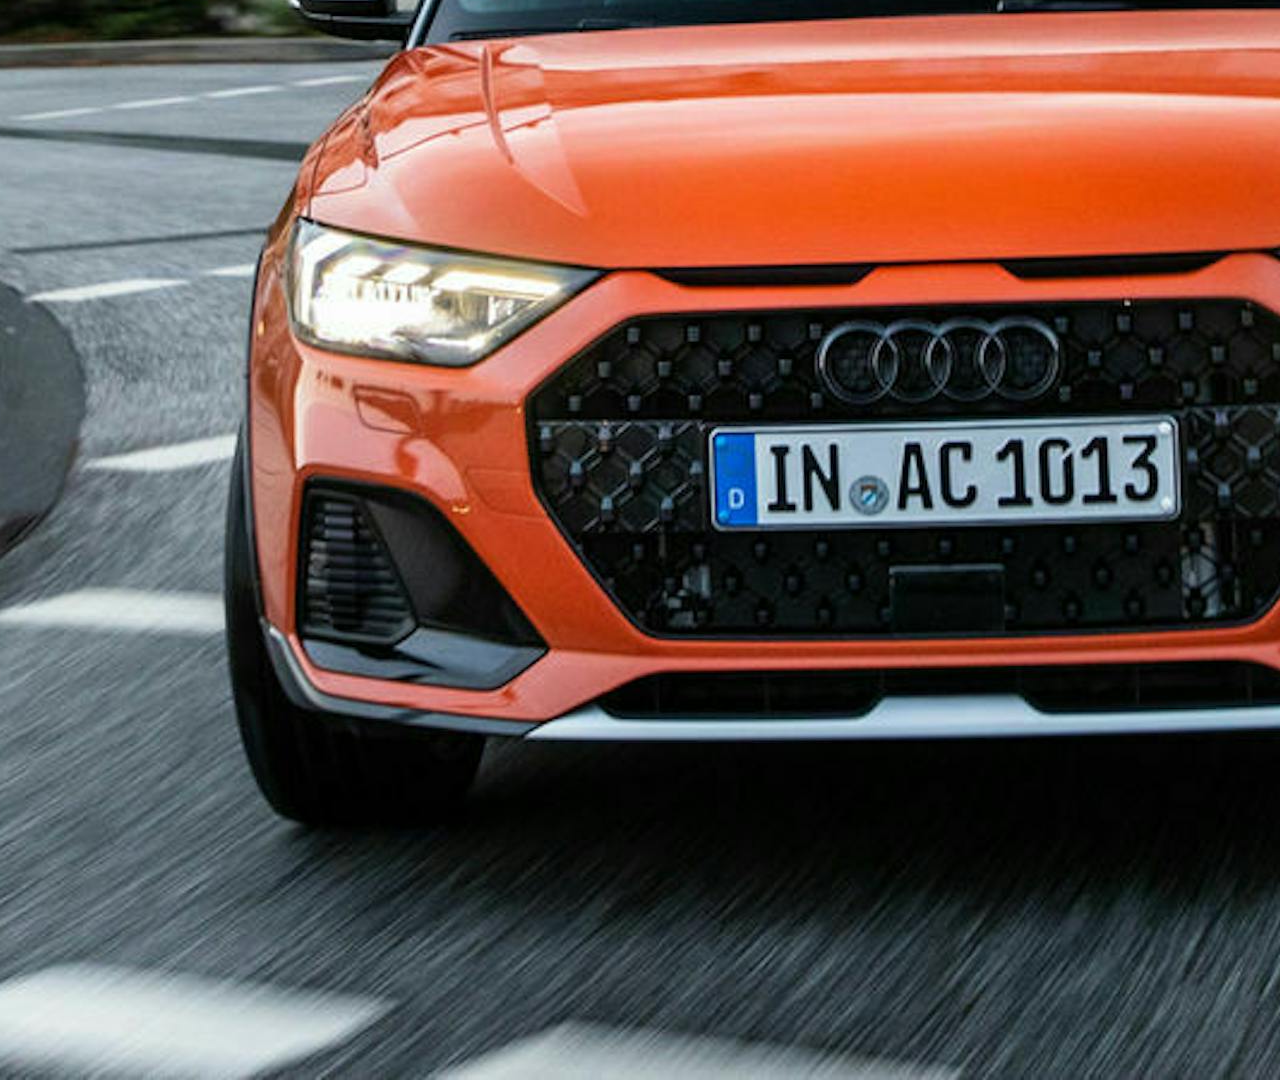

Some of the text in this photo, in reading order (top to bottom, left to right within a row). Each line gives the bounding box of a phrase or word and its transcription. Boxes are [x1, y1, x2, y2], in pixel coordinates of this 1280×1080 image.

[728, 488, 745, 510] D
[767, 435, 1160, 513] IN AC 1013
